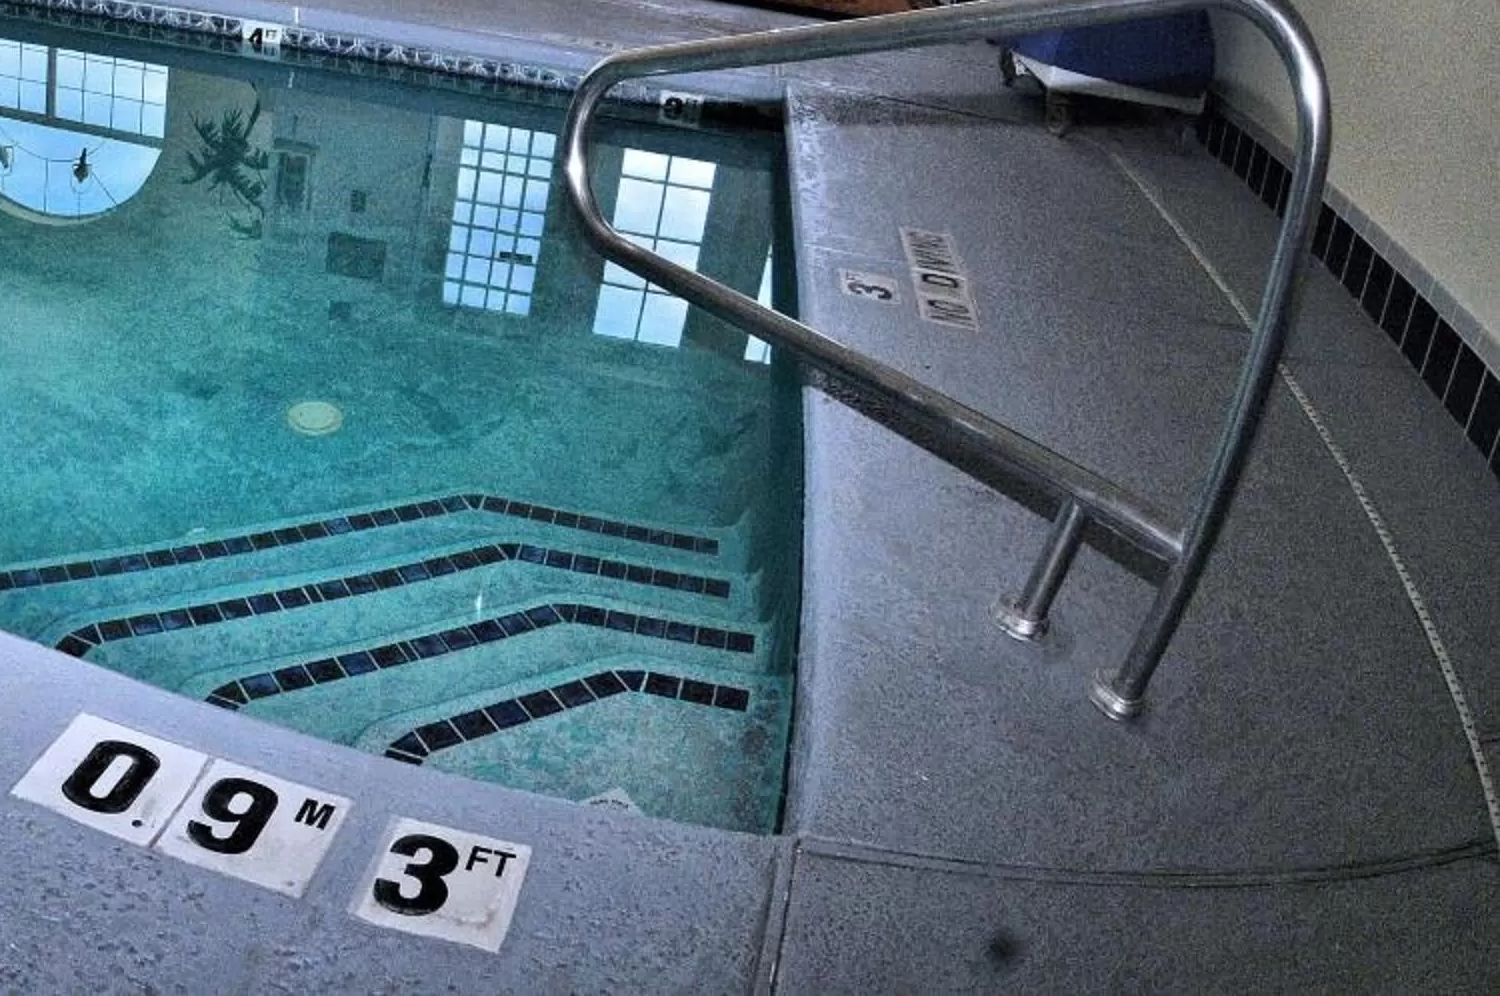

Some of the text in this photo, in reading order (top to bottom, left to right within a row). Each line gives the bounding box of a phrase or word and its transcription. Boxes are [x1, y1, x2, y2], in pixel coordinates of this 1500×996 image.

[847, 282, 893, 300] 3
[294, 798, 337, 830] M
[373, 834, 517, 916] 3 FT
